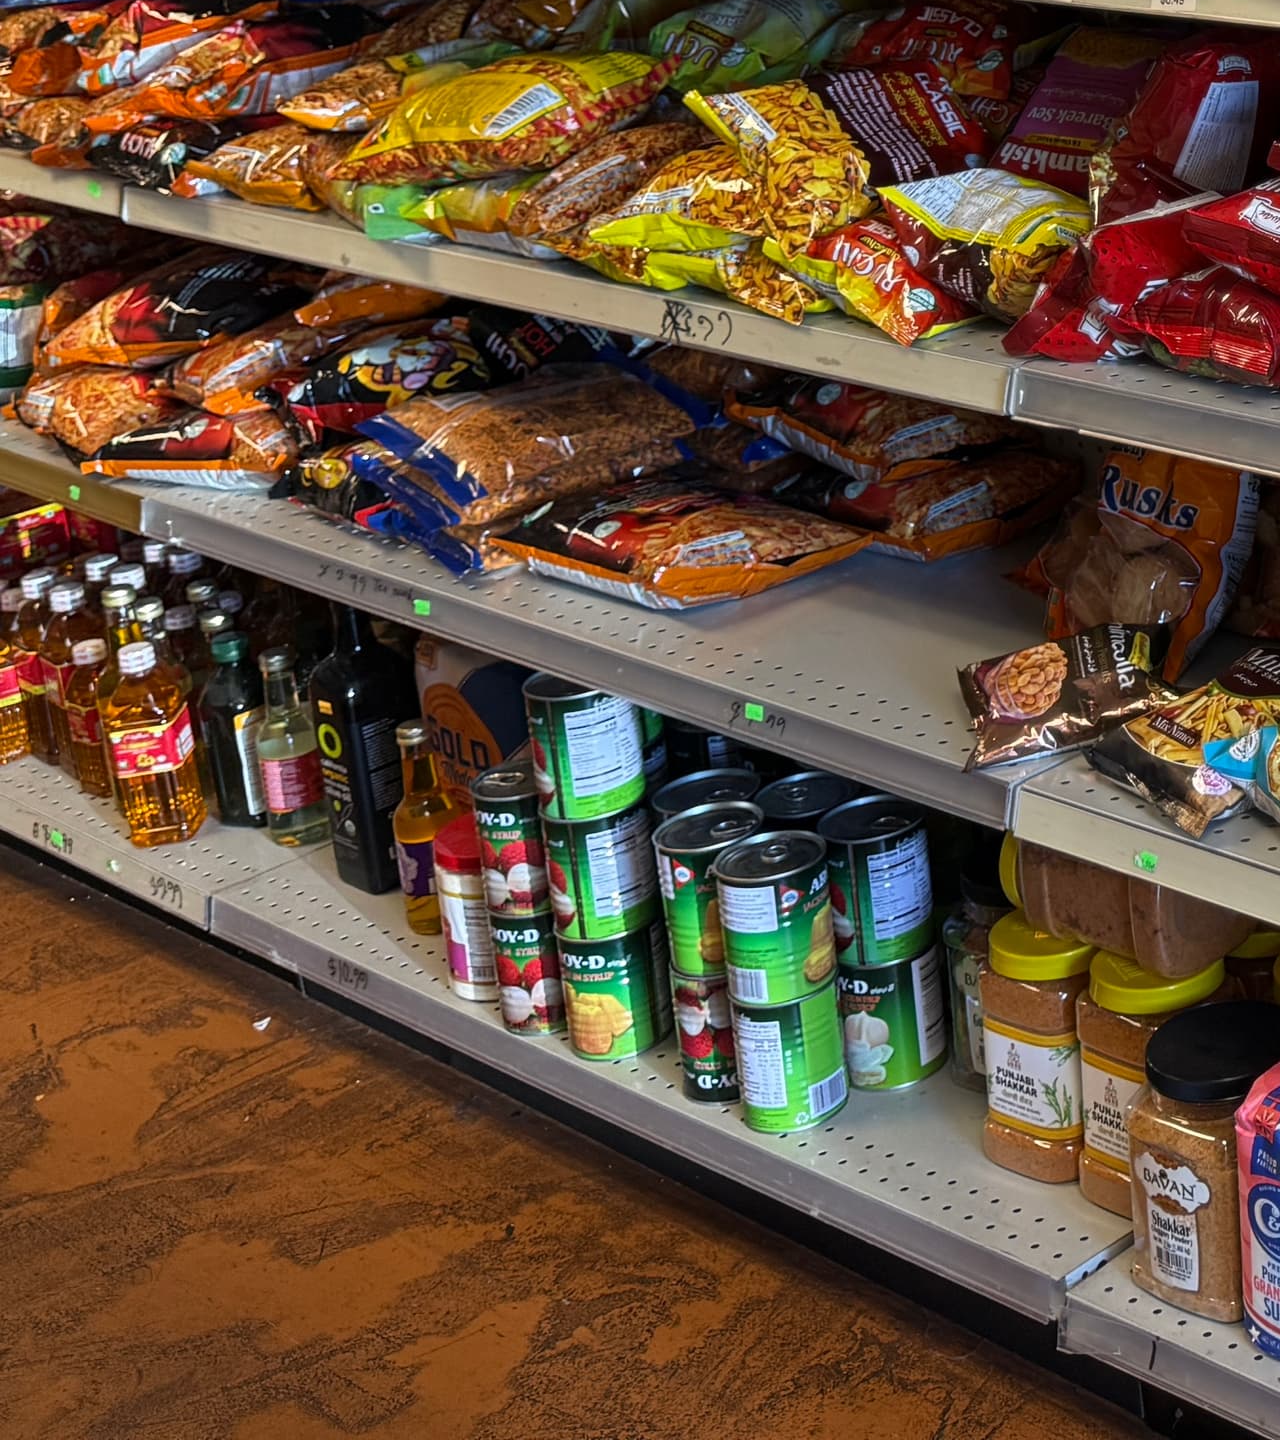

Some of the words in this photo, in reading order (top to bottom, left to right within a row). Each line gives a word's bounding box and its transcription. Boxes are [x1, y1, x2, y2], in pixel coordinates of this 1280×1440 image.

[1101, 464, 1199, 530] Rusks
[1151, 717, 1169, 735] Mix
[1168, 724, 1197, 747] Nimco
[994, 1065, 1036, 1087] PUNJABI
[994, 1075, 1039, 1099] SHAKKAR
[1090, 1111, 1129, 1133] SHAKKA
[1092, 1101, 1123, 1119] PUNJA
[1150, 1209, 1192, 1239] Shakkar
